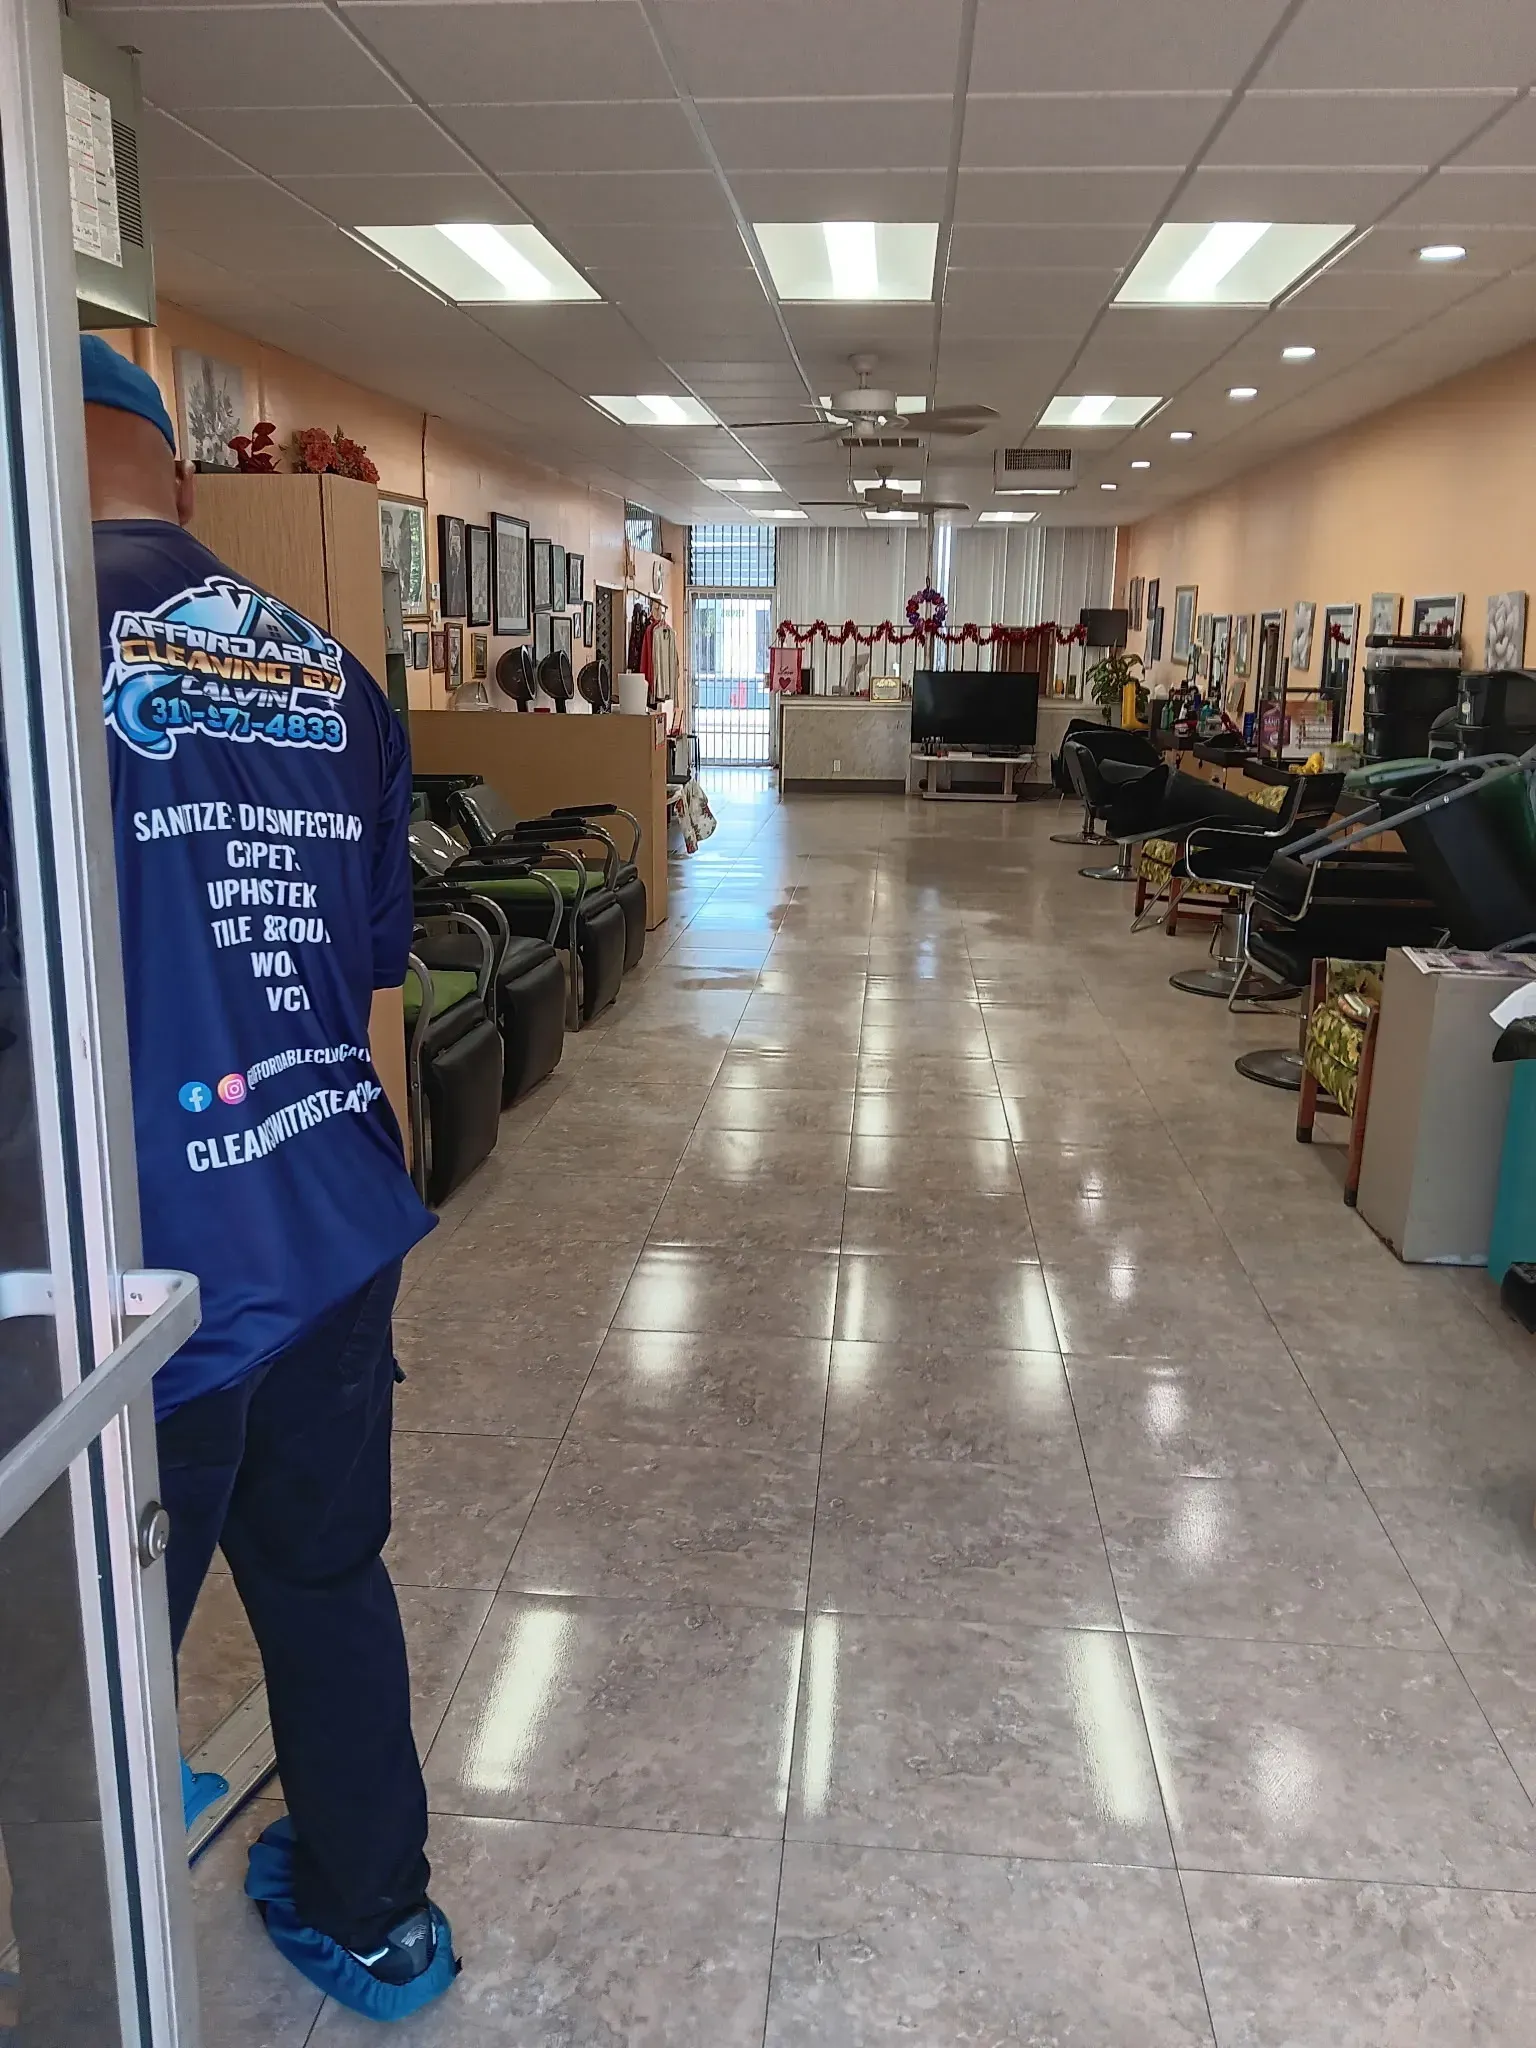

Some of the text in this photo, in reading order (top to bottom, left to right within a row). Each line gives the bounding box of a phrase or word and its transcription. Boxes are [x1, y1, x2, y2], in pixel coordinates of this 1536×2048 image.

[120, 616, 340, 675] AFFORDABLE
[120, 640, 291, 686] CLEANING
[181, 674, 289, 709] CALVIN
[210, 915, 253, 949] TILE
